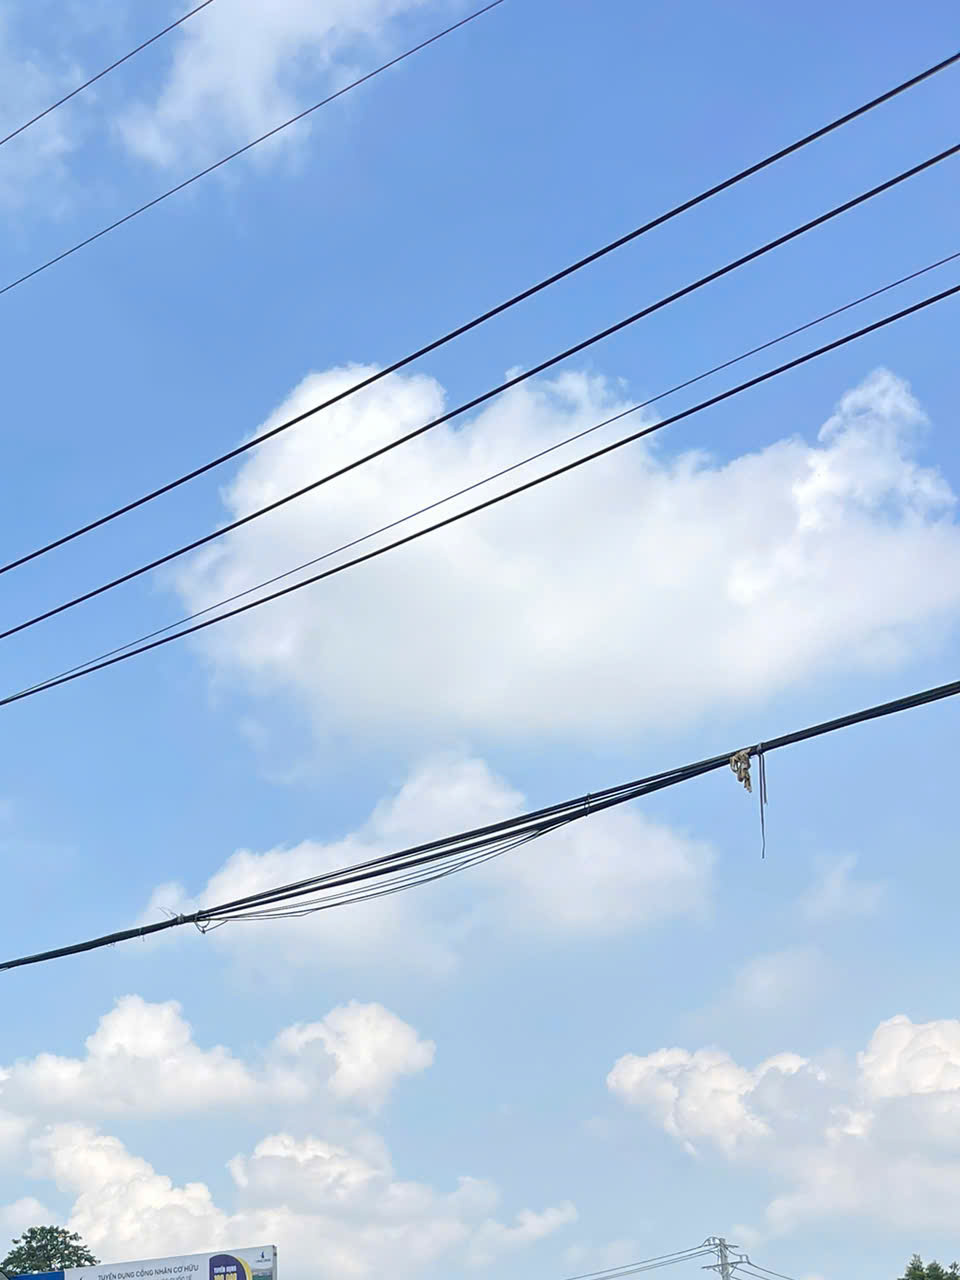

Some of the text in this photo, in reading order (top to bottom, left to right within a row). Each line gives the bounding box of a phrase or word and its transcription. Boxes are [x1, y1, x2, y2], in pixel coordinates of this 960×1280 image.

[118, 1271, 135, 1280] DỤNG
[136, 1269, 154, 1278] CÔNG
[154, 1267, 173, 1276] NHÂN
[173, 1265, 183, 1274] CƠ
[184, 1264, 199, 1272] HỮU
